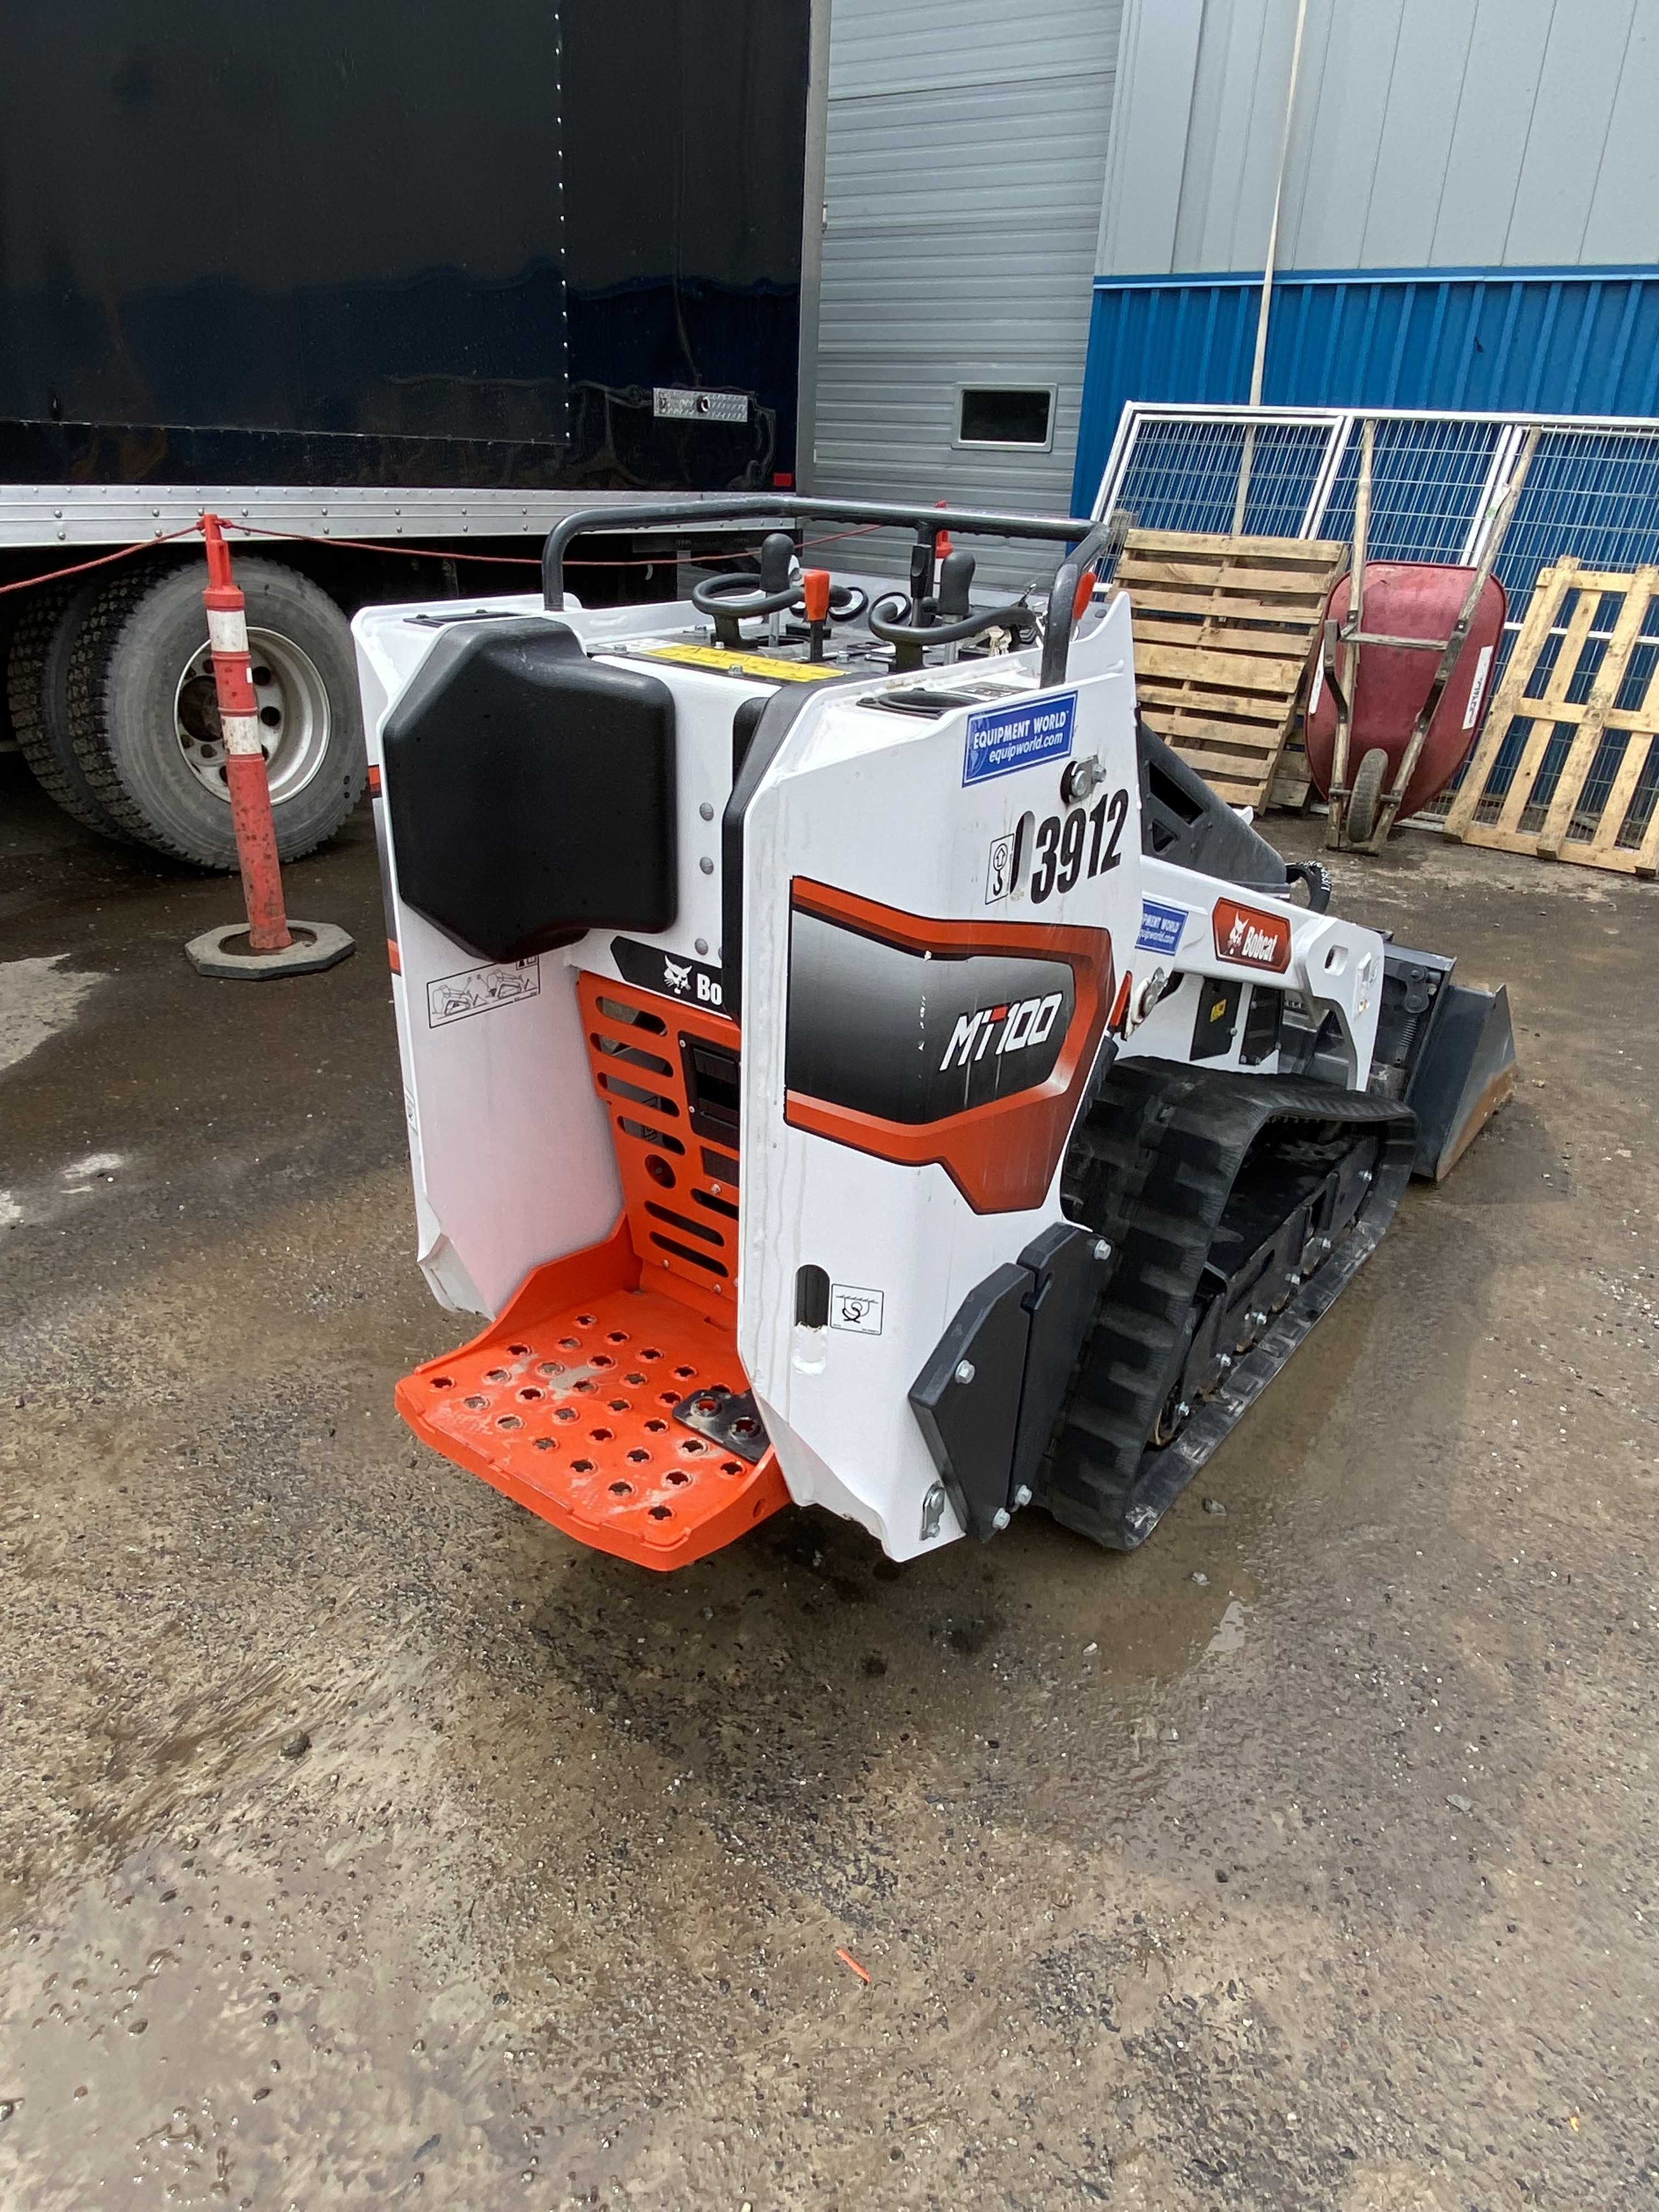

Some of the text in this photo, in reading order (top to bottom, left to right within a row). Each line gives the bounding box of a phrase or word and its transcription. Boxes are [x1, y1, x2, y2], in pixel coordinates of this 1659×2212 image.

[973, 711, 1066, 750] EQUIPMENT WORLD
[989, 732, 1063, 764] equipworld.com
[1030, 788, 1129, 904] 3912
[1242, 926, 1278, 962] Bobcat
